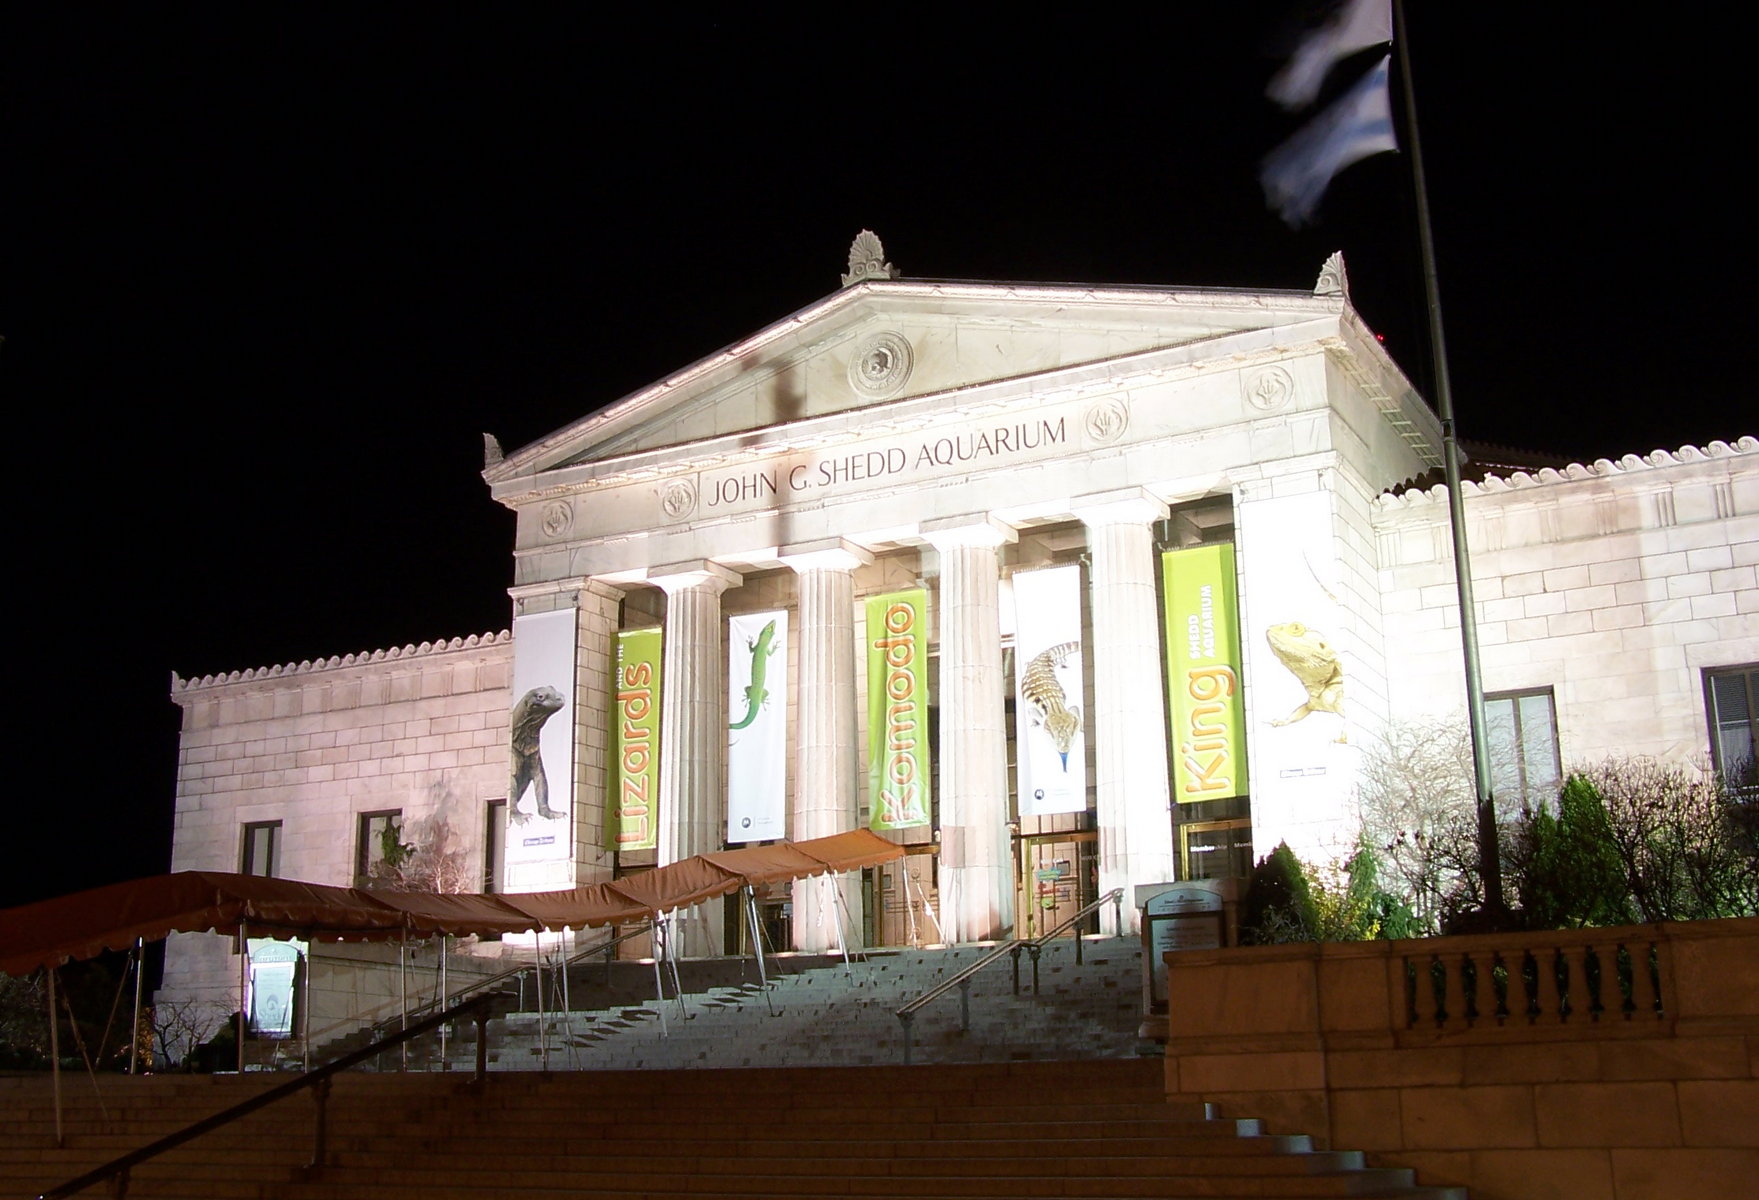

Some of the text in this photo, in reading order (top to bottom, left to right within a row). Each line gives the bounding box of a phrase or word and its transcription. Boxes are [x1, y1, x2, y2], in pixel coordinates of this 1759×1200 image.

[708, 416, 1064, 507] JOHN G. SHEDD AQUARIUM
[1188, 614, 1201, 660] SHEDD
[1201, 584, 1215, 658] AQUARIUM
[614, 661, 652, 844] Lizards
[875, 602, 917, 822] Komodo
[1182, 665, 1238, 793] King
